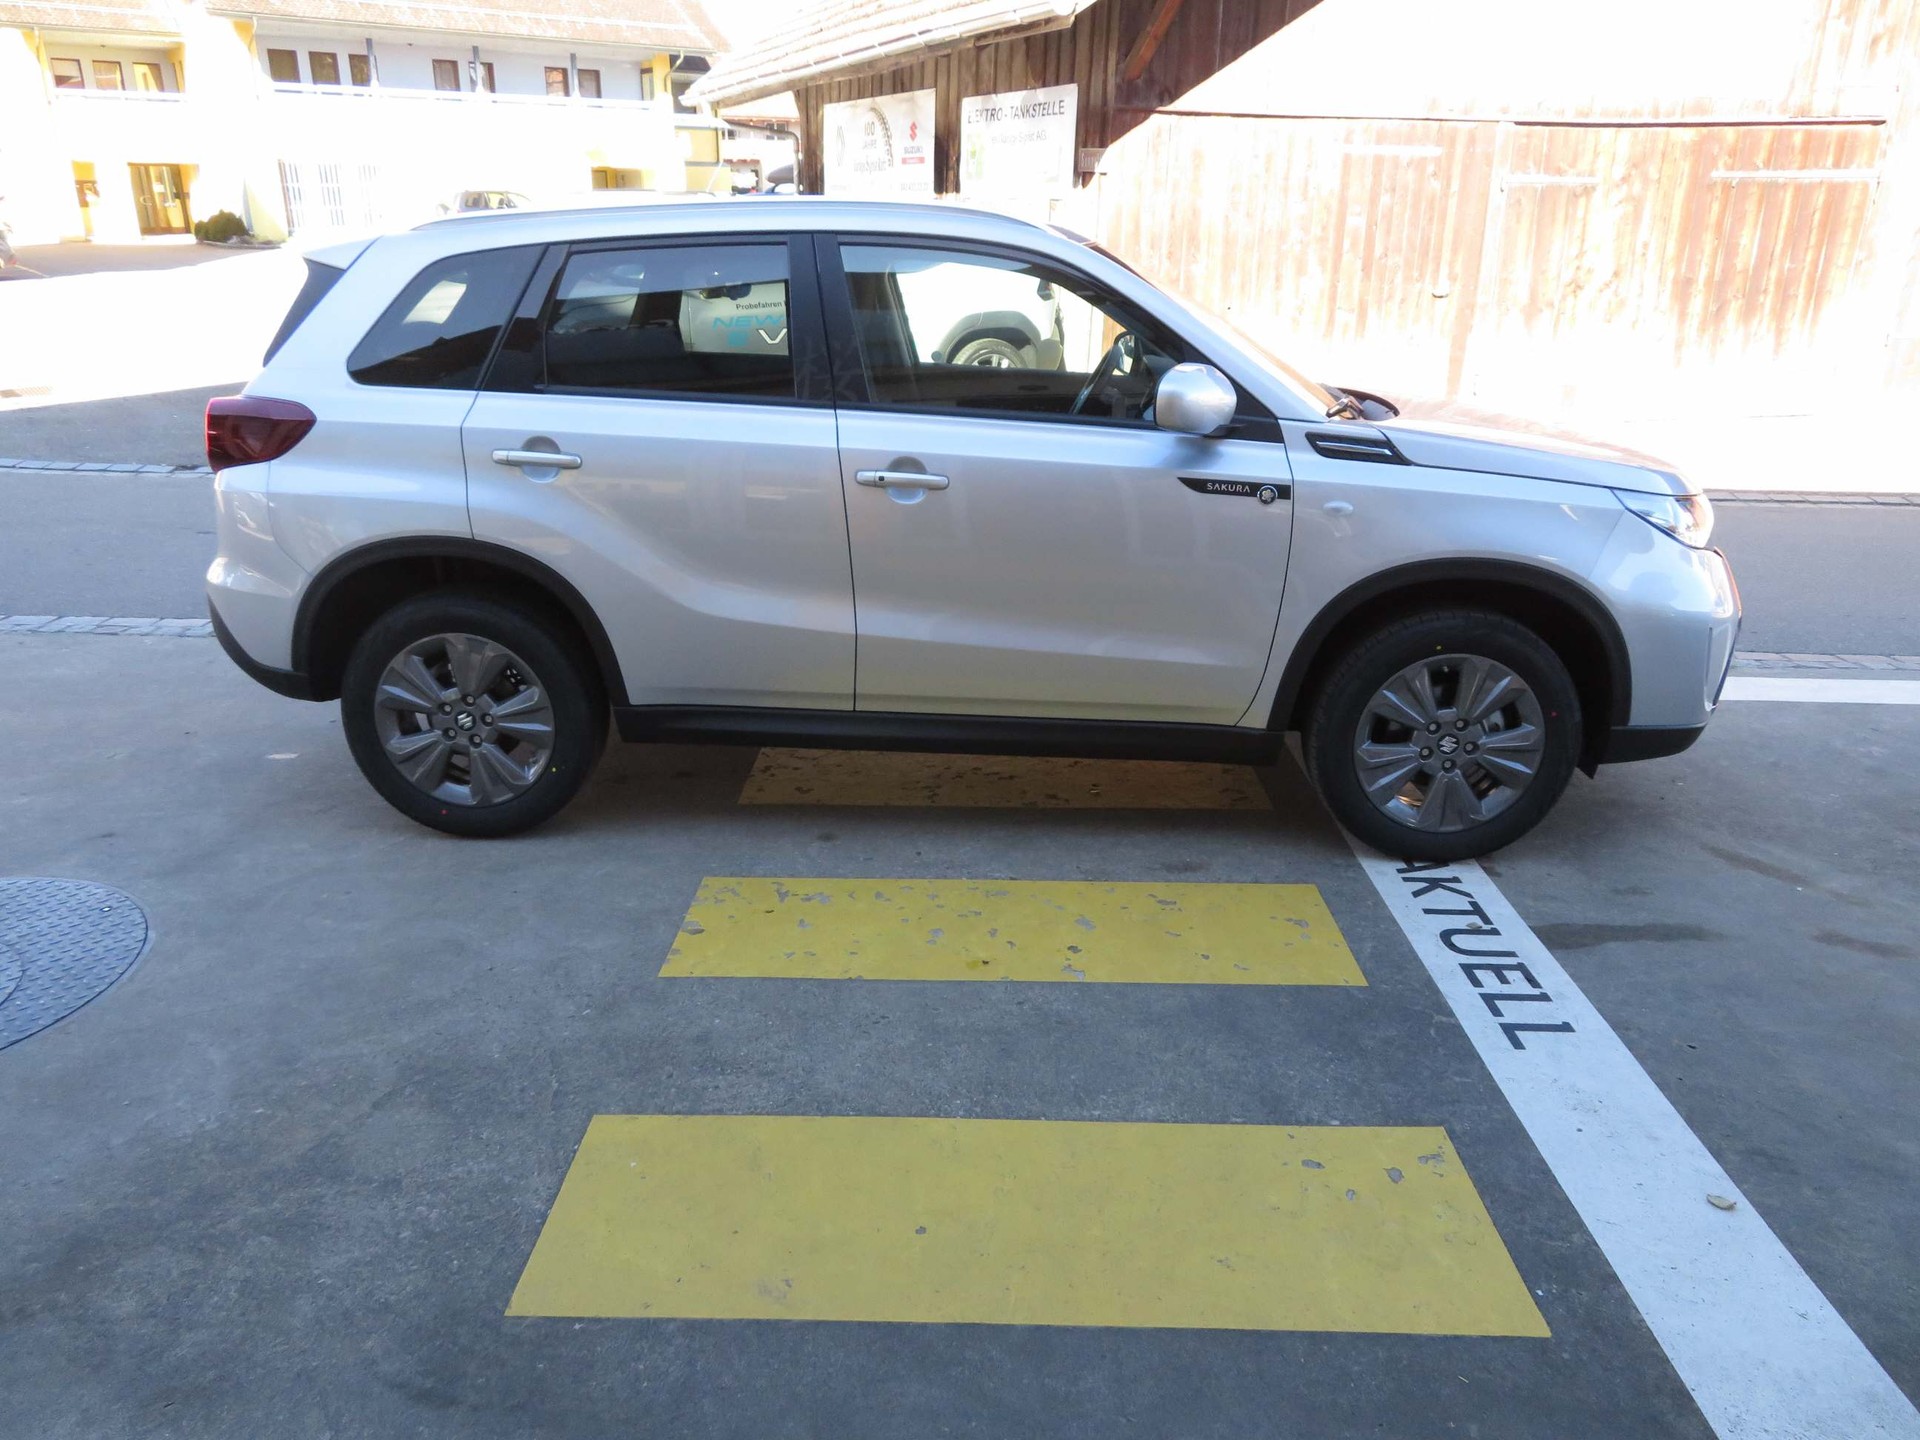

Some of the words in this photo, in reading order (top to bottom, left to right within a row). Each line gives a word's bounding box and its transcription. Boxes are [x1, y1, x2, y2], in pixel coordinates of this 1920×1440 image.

[1010, 99, 1065, 120] TANKSTELLE
[864, 121, 875, 136] 100
[904, 145, 923, 154] SUZUKI
[736, 300, 783, 310] Probefahren
[713, 315, 784, 328] NEW
[1207, 482, 1250, 493] SAKURA
